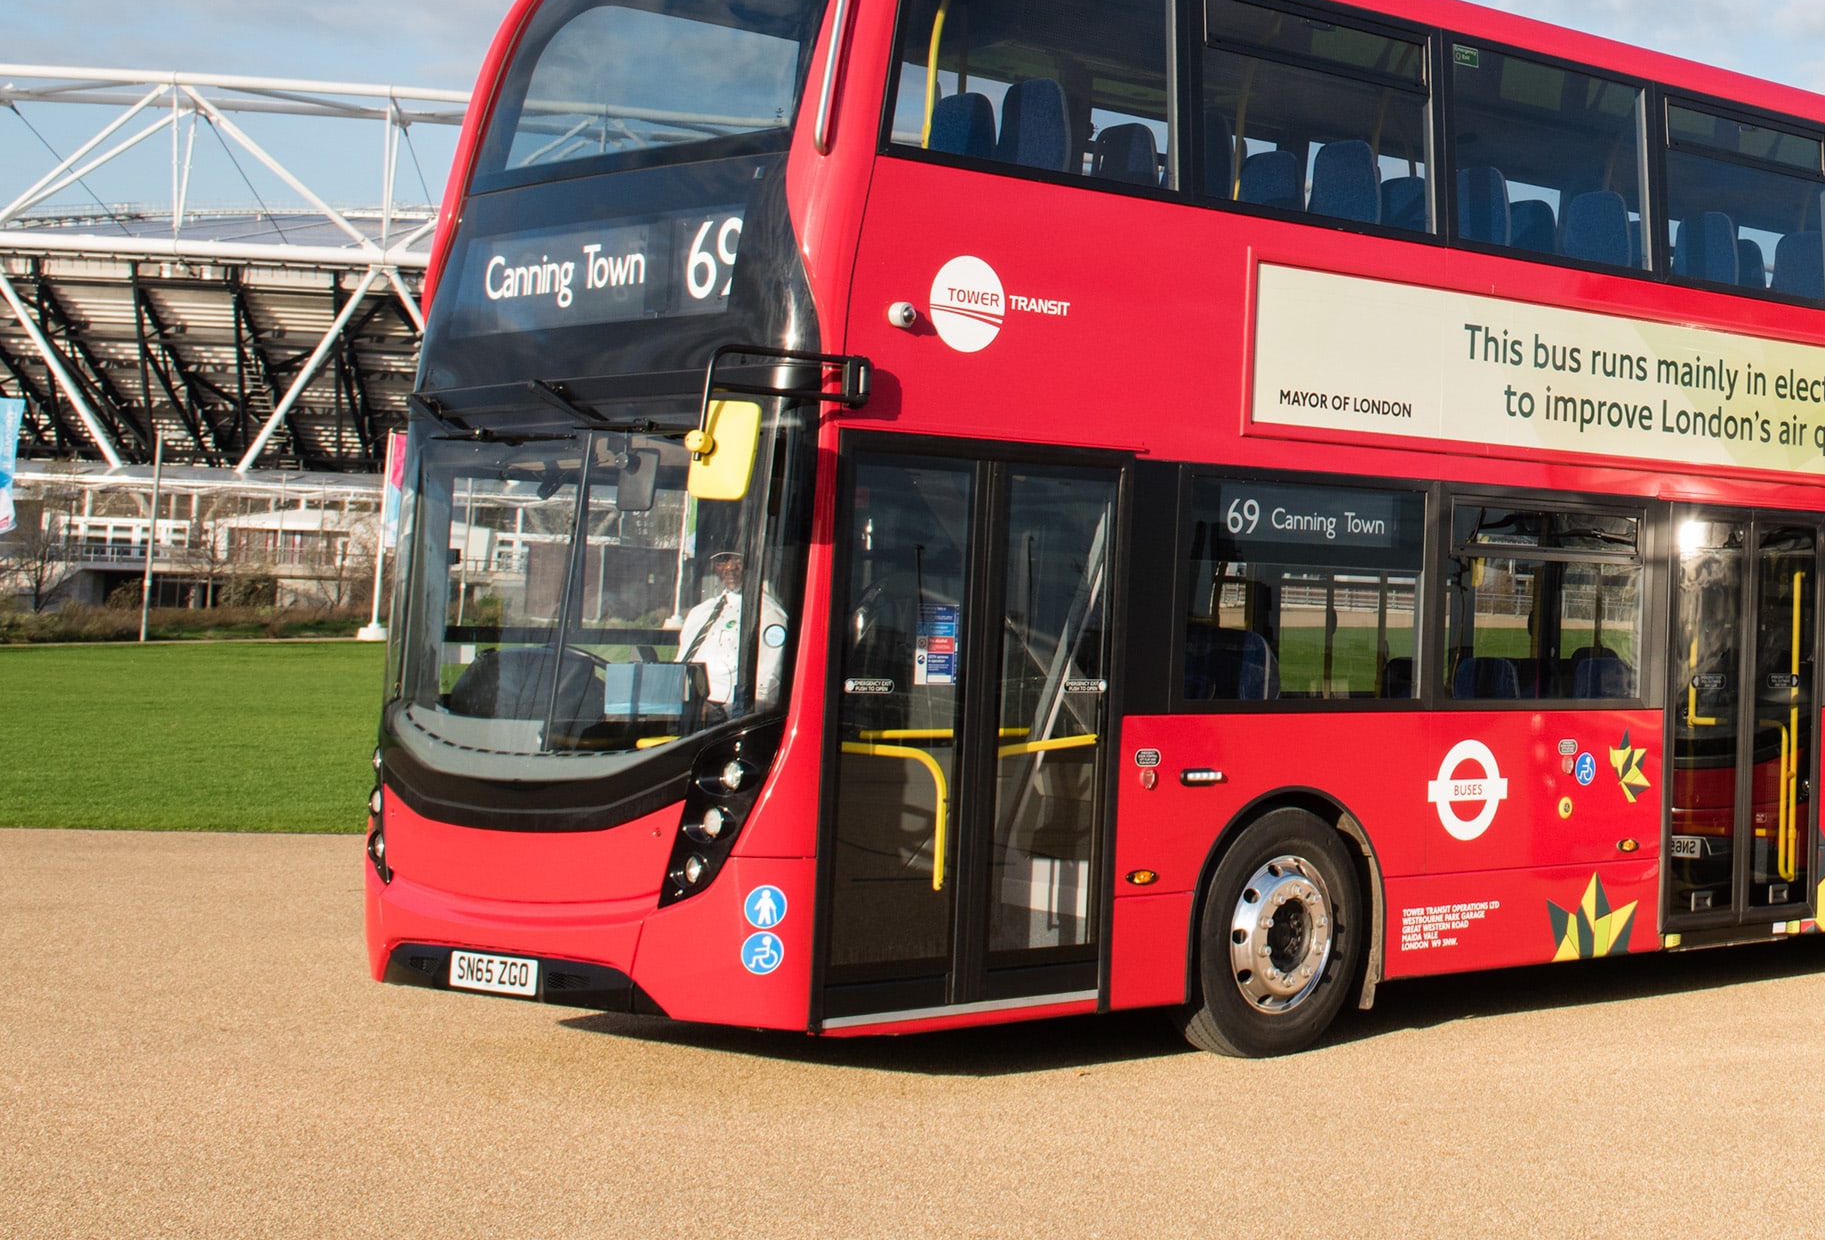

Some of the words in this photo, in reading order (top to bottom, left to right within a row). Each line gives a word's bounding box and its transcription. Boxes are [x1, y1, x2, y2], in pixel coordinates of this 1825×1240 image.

[485, 255, 575, 308] Canning
[583, 243, 646, 289] Town
[947, 287, 1000, 307] TOWER
[1009, 295, 1070, 316] TRANSIT
[1464, 323, 1523, 367] This
[1533, 333, 1582, 374] bus
[1591, 348, 1648, 382] runs
[1657, 356, 1739, 400] mainly
[1747, 363, 1766, 396] in
[1279, 389, 1328, 409] MAYOR
[1331, 395, 1350, 411] OF
[1353, 397, 1412, 418] LONDON
[1504, 384, 1535, 418] to
[1545, 385, 1653, 433] improve
[1662, 399, 1771, 443] London's
[1778, 414, 1808, 447] air
[1226, 498, 1260, 535] 69
[1271, 507, 1337, 540] Canning
[1344, 512, 1385, 535] Town
[1454, 783, 1483, 796] BUSES
[1402, 908, 1424, 917] TOWER
[1426, 905, 1451, 915] TRANSIT
[1452, 902, 1488, 913] OPERATIONS
[1489, 900, 1500, 910] LTD
[1402, 914, 1444, 926] WESTBOURNE
[1445, 912, 1460, 922] PARK
[1461, 910, 1485, 920] GARAGE
[1402, 925, 1422, 934] GREAT
[1423, 922, 1451, 932] WESTERN
[1451, 920, 1469, 929] ROAD
[1402, 933, 1422, 942] MAIDA
[1423, 931, 1439, 940] VALE
[1401, 941, 1429, 951] LONDON
[457, 955, 494, 983] SN65
[497, 960, 529, 987] ZGO
